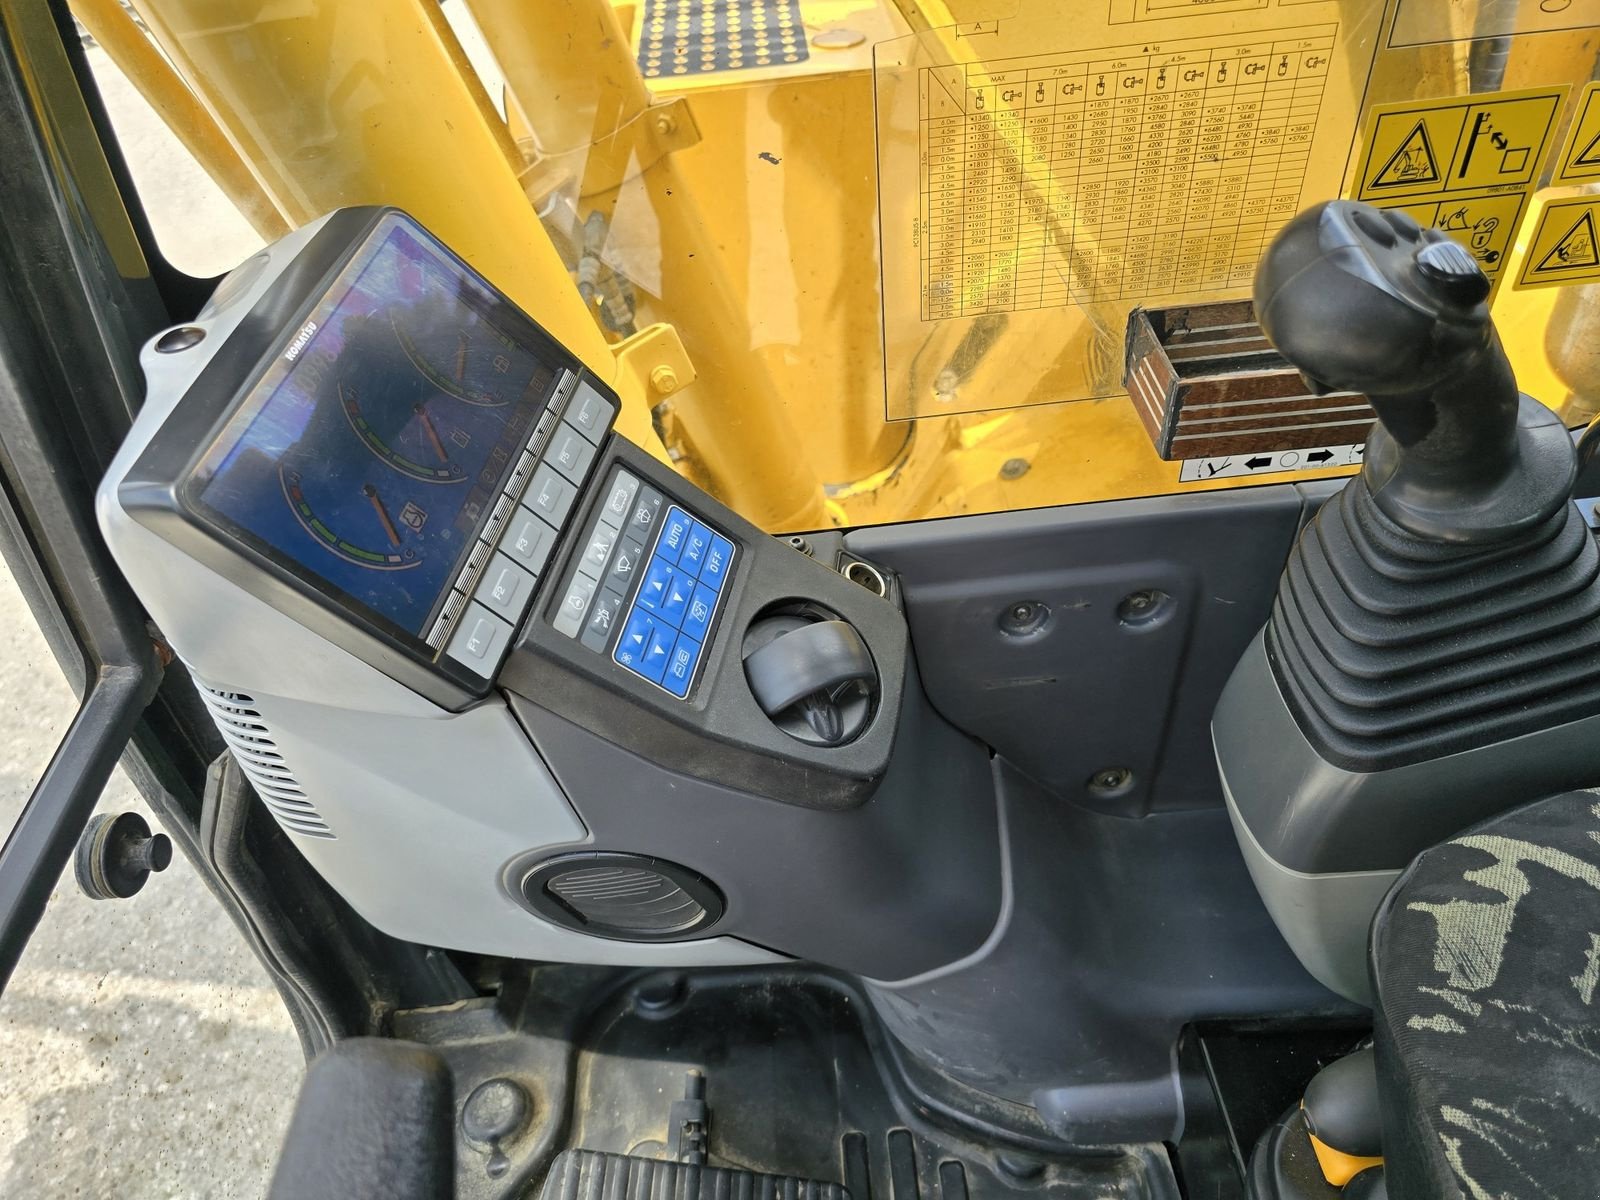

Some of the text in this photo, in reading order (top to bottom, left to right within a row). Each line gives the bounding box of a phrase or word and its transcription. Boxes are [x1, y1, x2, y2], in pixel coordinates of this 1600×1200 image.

[1152, 44, 1160, 52] kg
[285, 322, 317, 361] KOMATSU
[578, 412, 589, 424] F6
[559, 452, 570, 464] F5
[538, 493, 549, 507] F4
[667, 524, 683, 548] AUTO
[517, 538, 528, 552] F3
[689, 538, 704, 560] A/C
[709, 552, 723, 574] OFF
[494, 585, 505, 600] F2
[468, 638, 480, 653] F1
